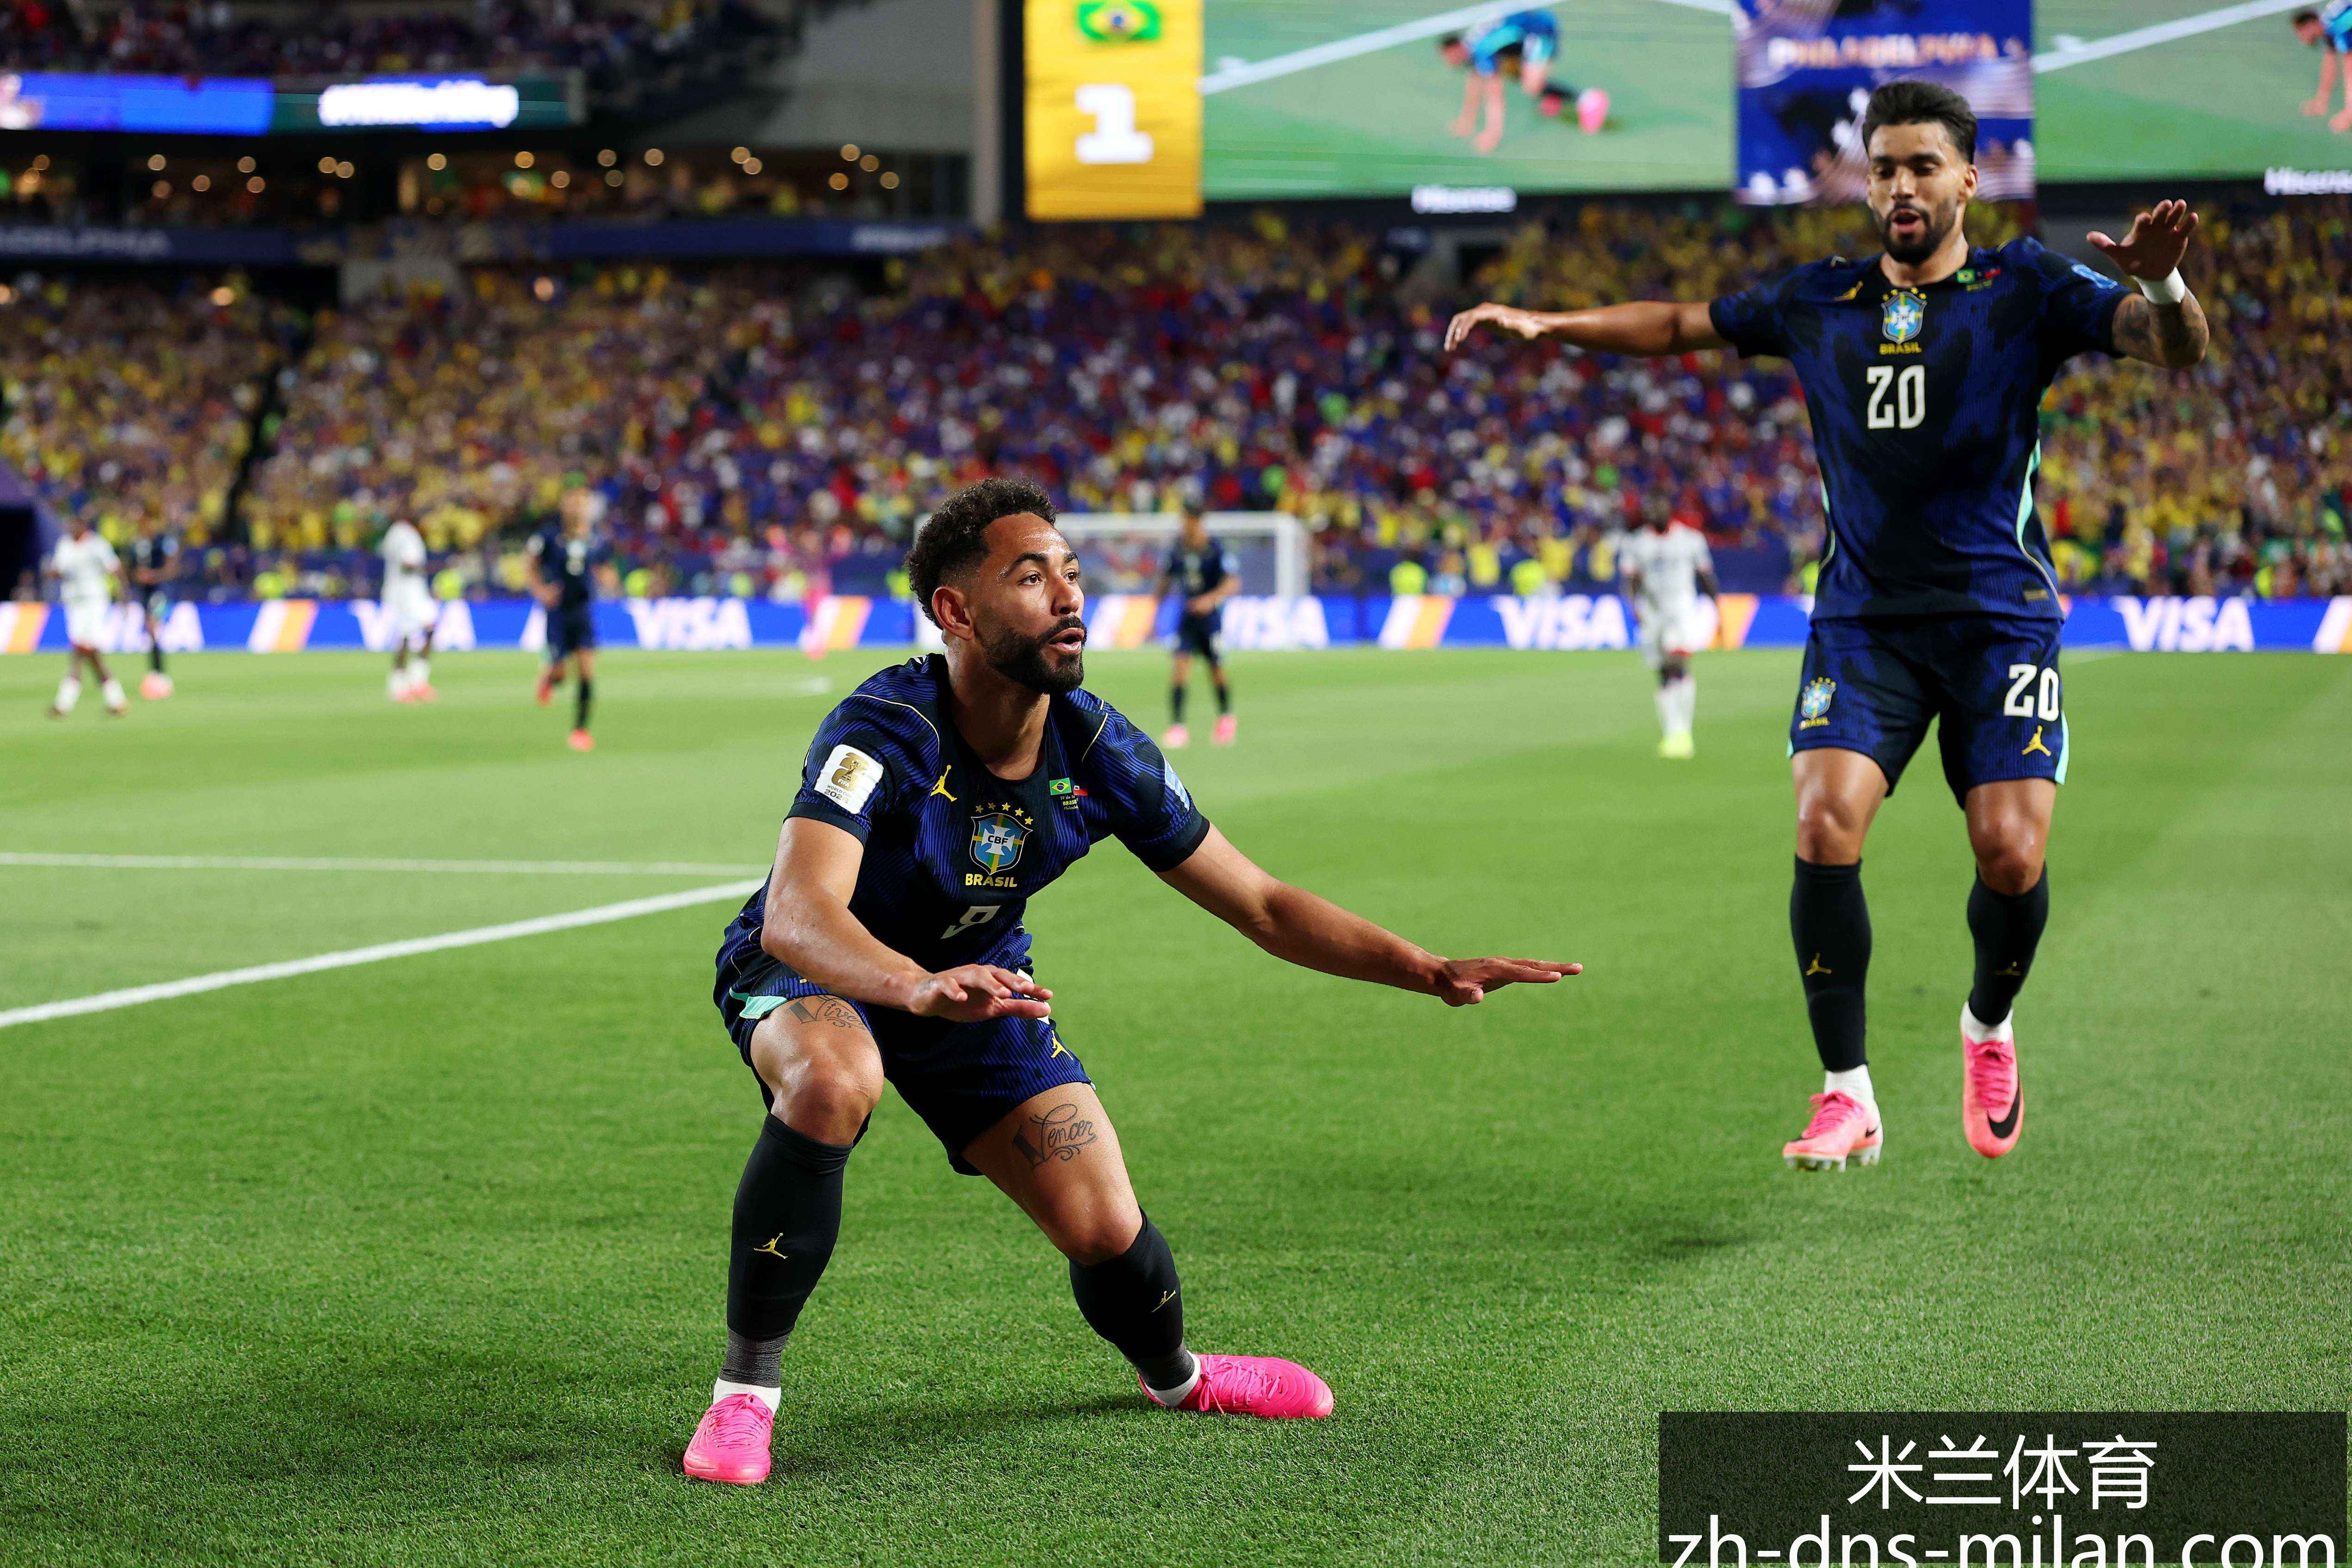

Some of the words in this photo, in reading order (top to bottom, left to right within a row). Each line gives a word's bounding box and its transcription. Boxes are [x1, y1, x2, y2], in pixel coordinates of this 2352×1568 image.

[1075, 84, 1155, 164] 1
[1879, 342, 1922, 355] BRASIL
[1866, 364, 1925, 430] 20
[623, 596, 754, 650] VISA
[1491, 594, 1627, 650] VISA
[2109, 595, 2254, 652] VISA
[2004, 664, 2059, 721] 20
[987, 835, 1009, 845] CBF
[965, 873, 1018, 888] BRASIL
[940, 905, 1001, 940] 9
